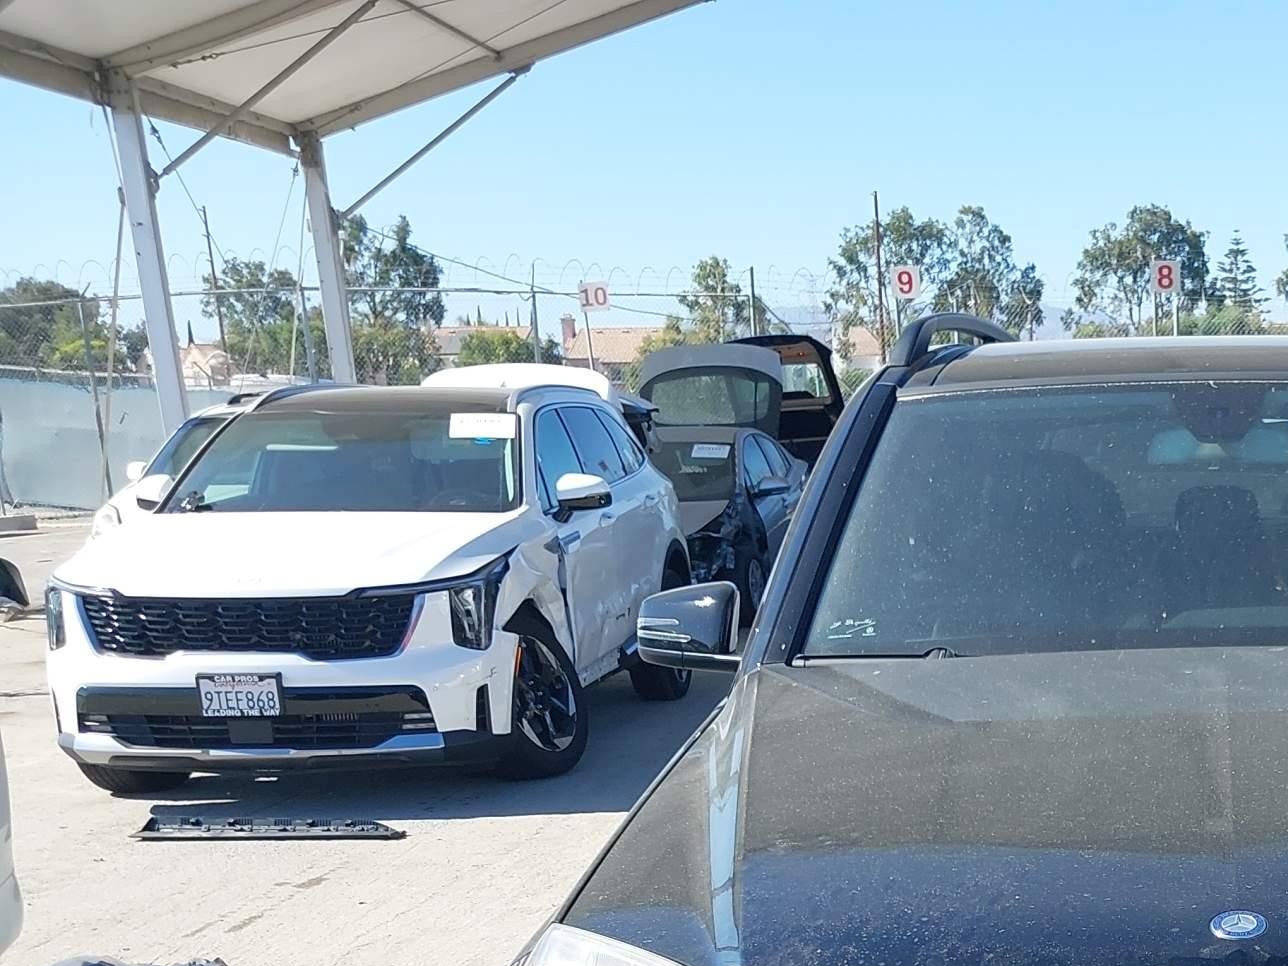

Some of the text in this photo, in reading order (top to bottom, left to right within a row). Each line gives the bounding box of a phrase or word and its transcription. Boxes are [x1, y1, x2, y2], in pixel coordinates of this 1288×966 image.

[897, 270, 913, 294] 9
[1158, 264, 1174, 289] 8
[580, 287, 607, 307] 10
[202, 707, 281, 717] LEADING THE WAY
[204, 690, 277, 712] 9TEF868
